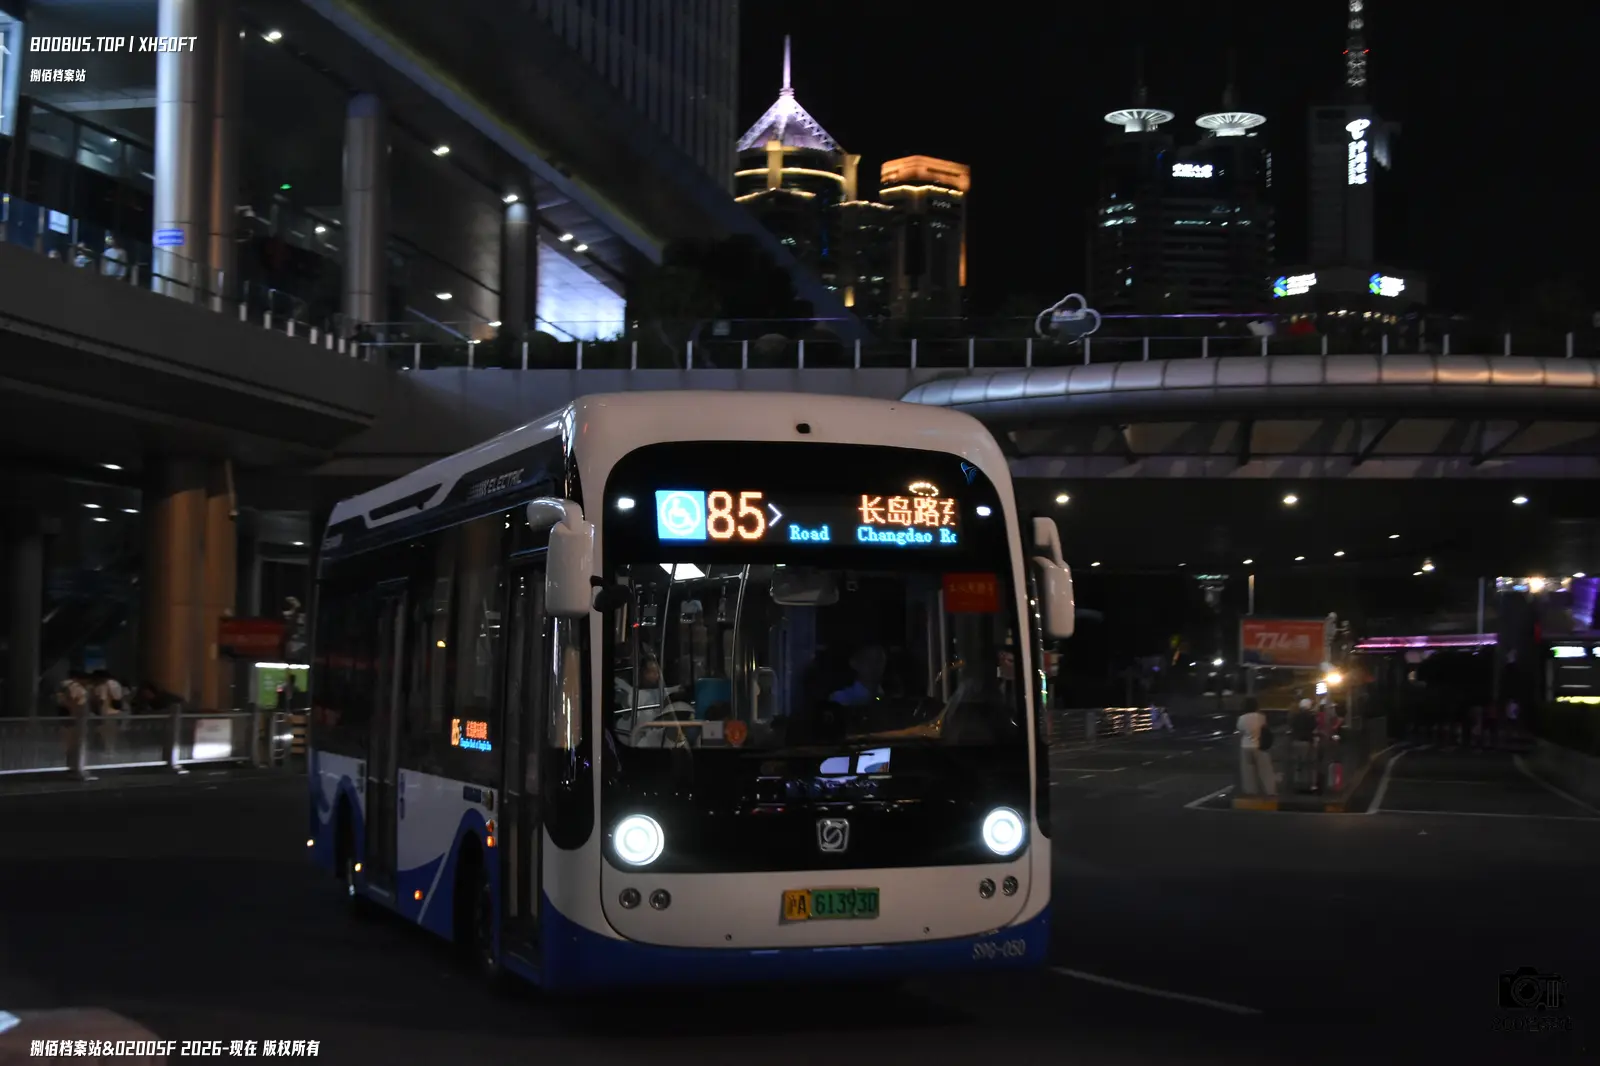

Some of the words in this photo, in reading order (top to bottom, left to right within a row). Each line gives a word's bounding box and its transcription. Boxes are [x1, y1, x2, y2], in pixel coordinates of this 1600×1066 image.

[707, 491, 765, 540] 85
[789, 525, 830, 541] Road
[857, 526, 933, 546] Changdao
